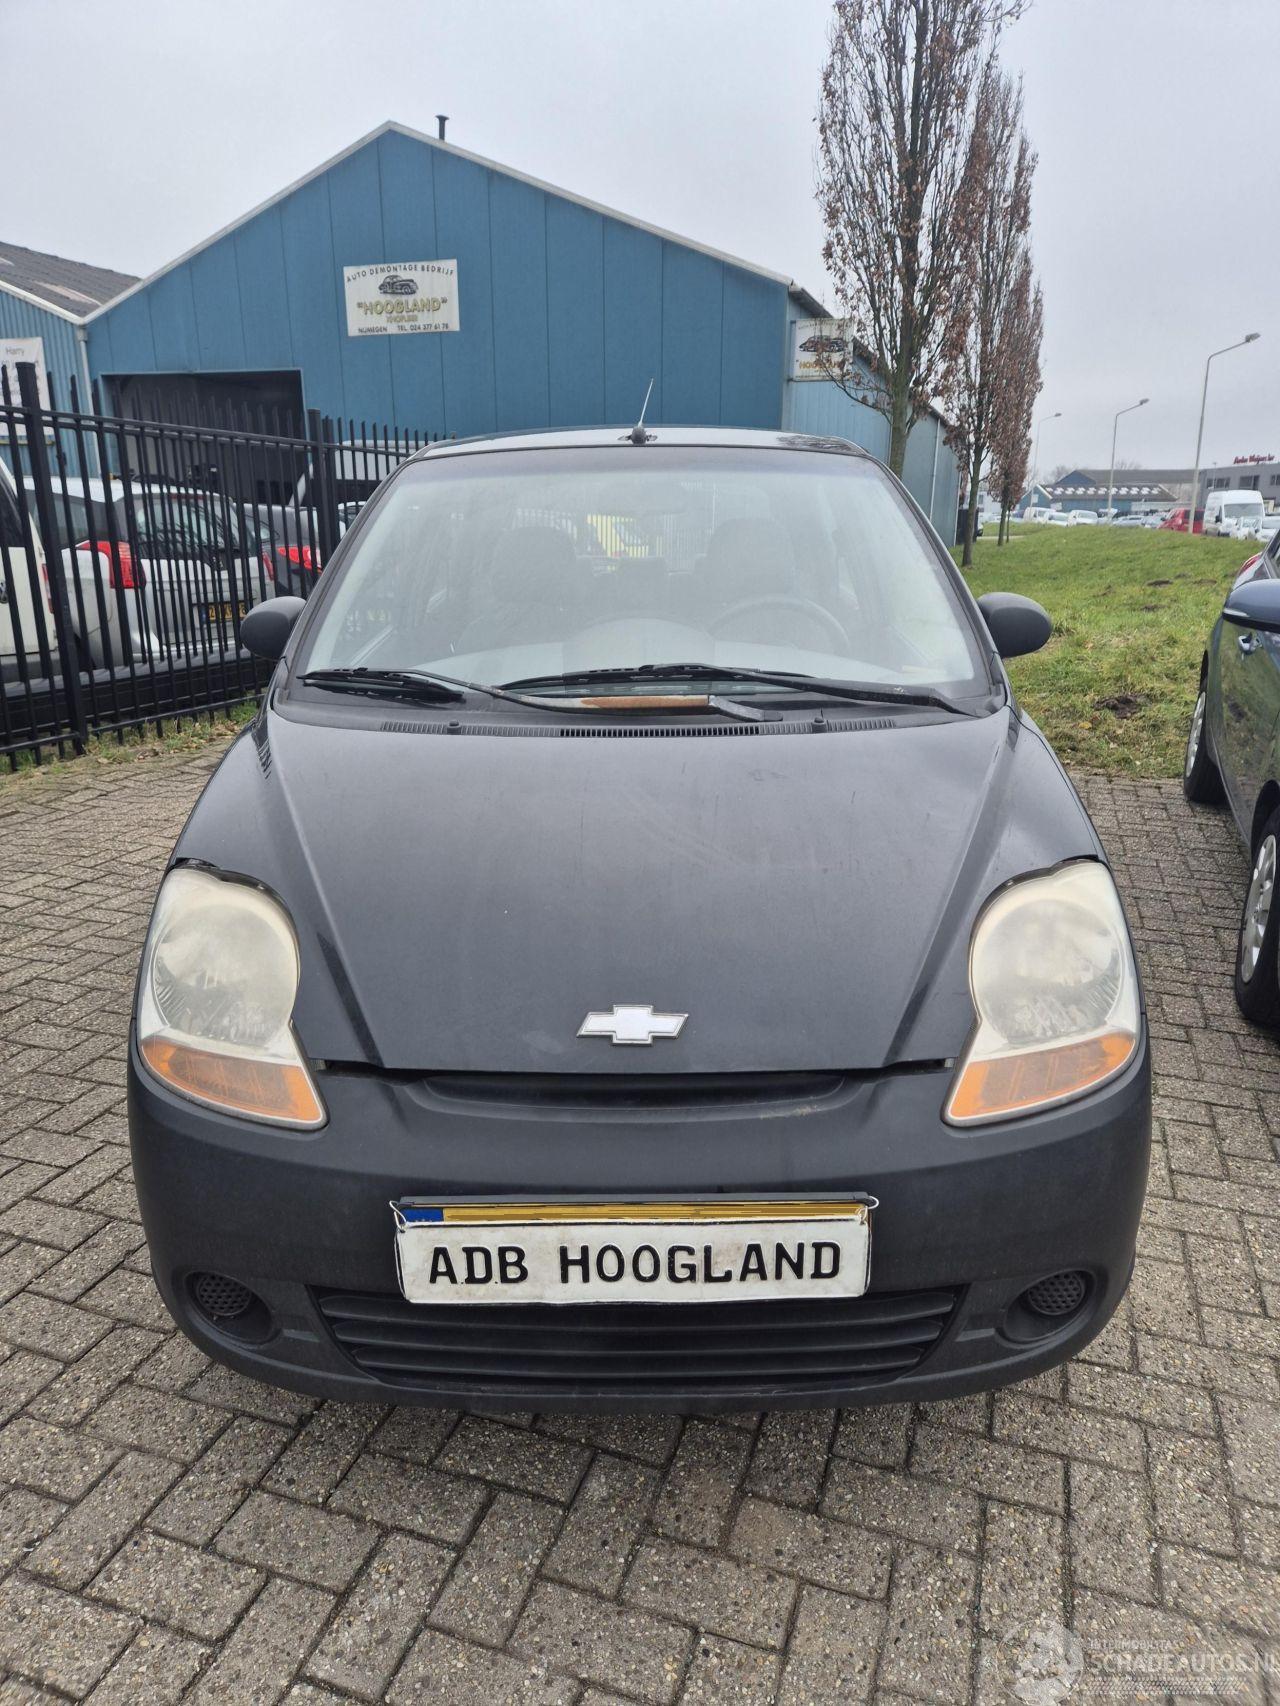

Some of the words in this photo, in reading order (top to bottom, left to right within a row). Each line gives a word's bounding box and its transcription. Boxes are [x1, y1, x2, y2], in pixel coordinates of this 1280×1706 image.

[346, 270, 367, 282] AUTO
[369, 264, 418, 275] DEMONTAGE
[421, 264, 454, 276] BEDRIJF
[358, 326, 388, 334] NIJMEGEN
[560, 1241, 841, 1284] HOOGLAND
